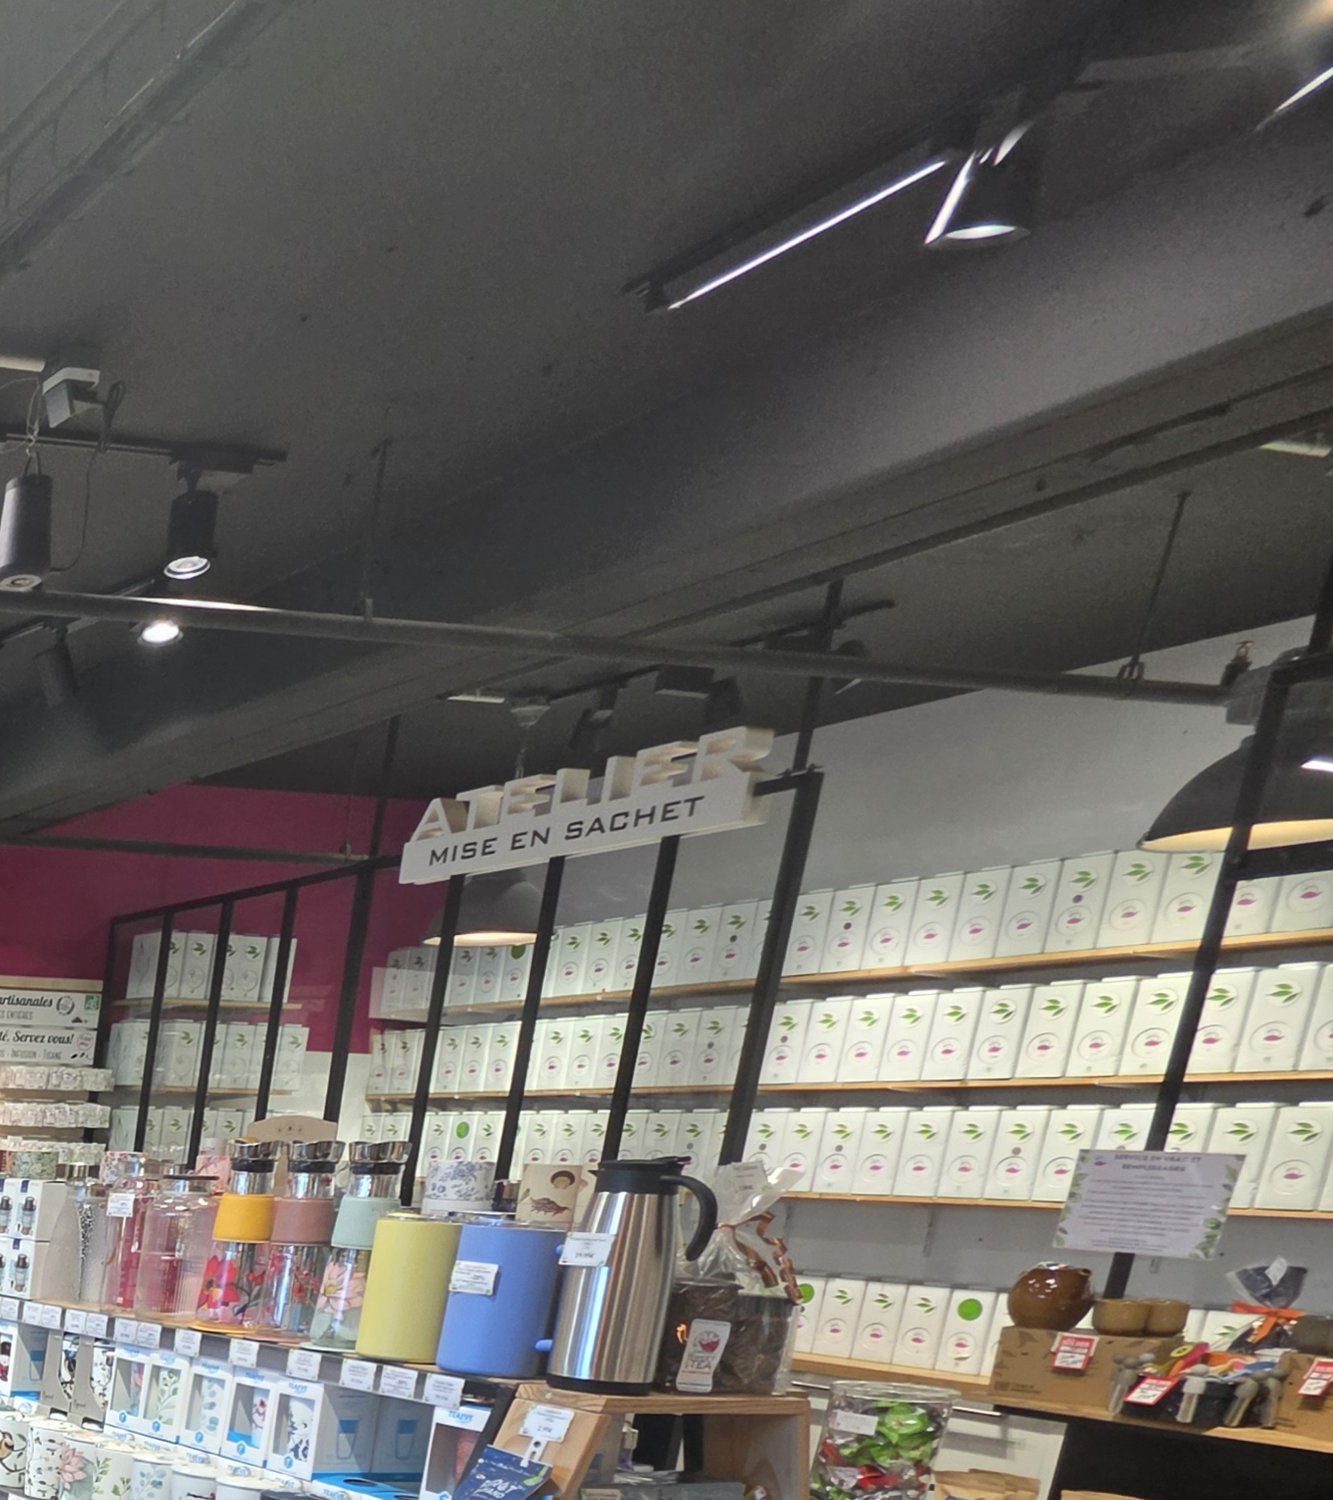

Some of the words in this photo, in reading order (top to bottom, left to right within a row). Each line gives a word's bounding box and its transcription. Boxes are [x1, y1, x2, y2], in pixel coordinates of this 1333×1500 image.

[410, 726, 774, 842] ATELIER
[429, 837, 498, 867] MISE
[510, 827, 551, 851] EN
[564, 795, 705, 840] SACHET
[13, 1030, 45, 1043] Servez
[47, 1034, 74, 1045] vous!
